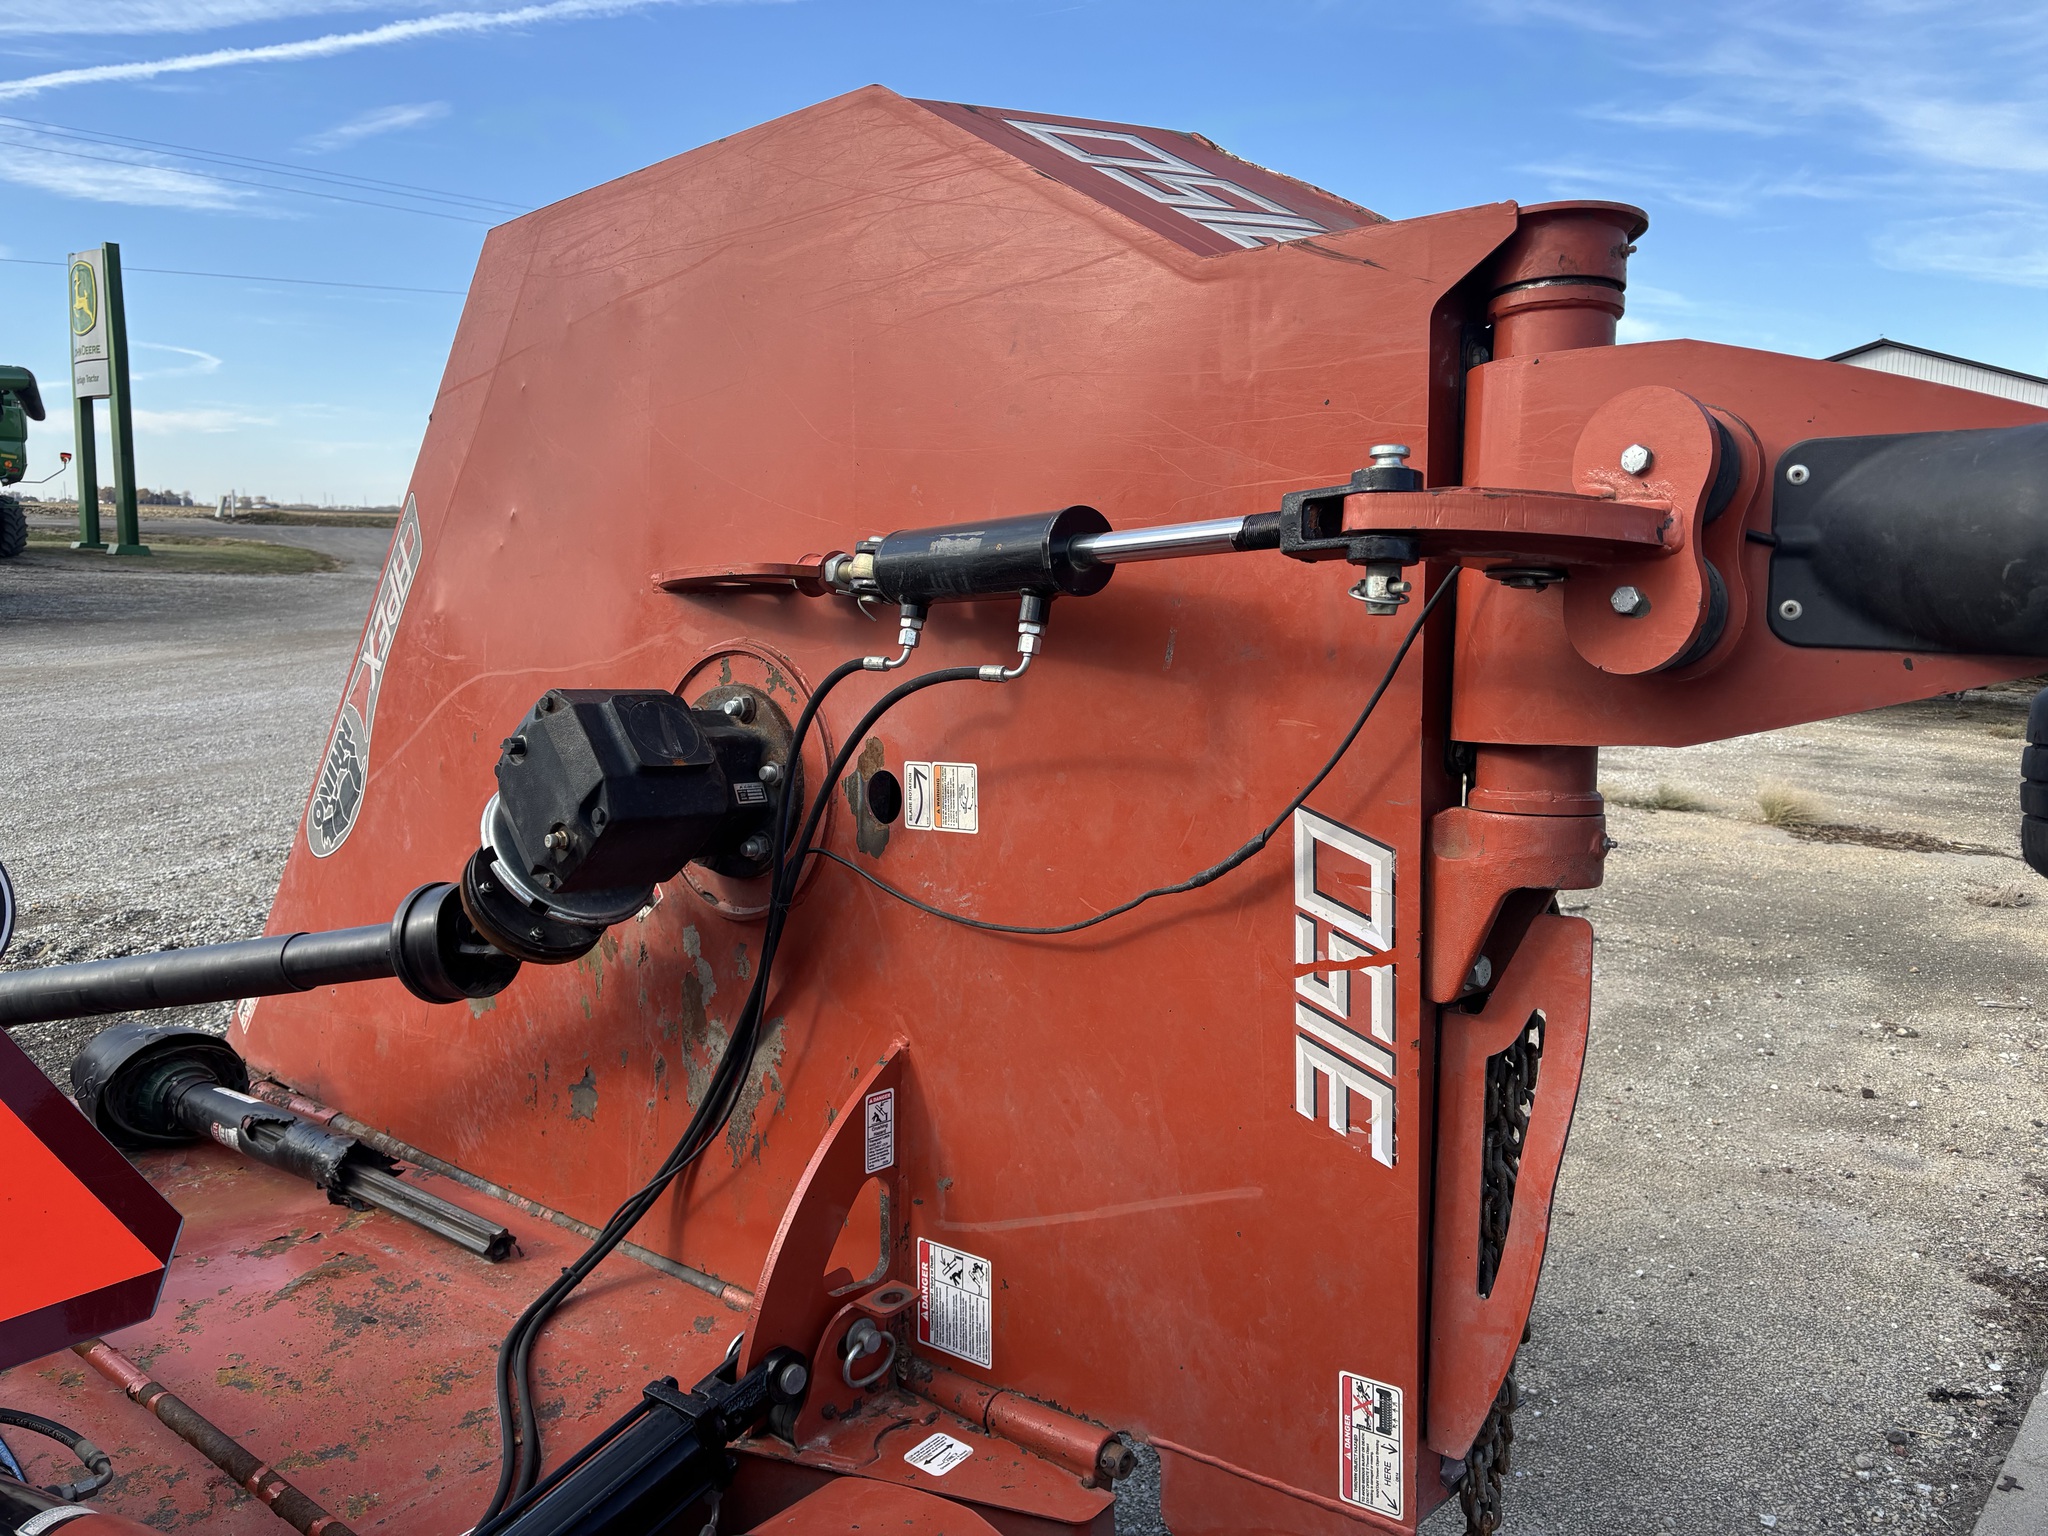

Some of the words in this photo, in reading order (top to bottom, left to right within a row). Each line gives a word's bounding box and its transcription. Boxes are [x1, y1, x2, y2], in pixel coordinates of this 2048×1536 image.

[82, 345, 101, 355] DEERE
[1295, 805, 1396, 1169] 3150
[873, 1093, 890, 1102] DANGER
